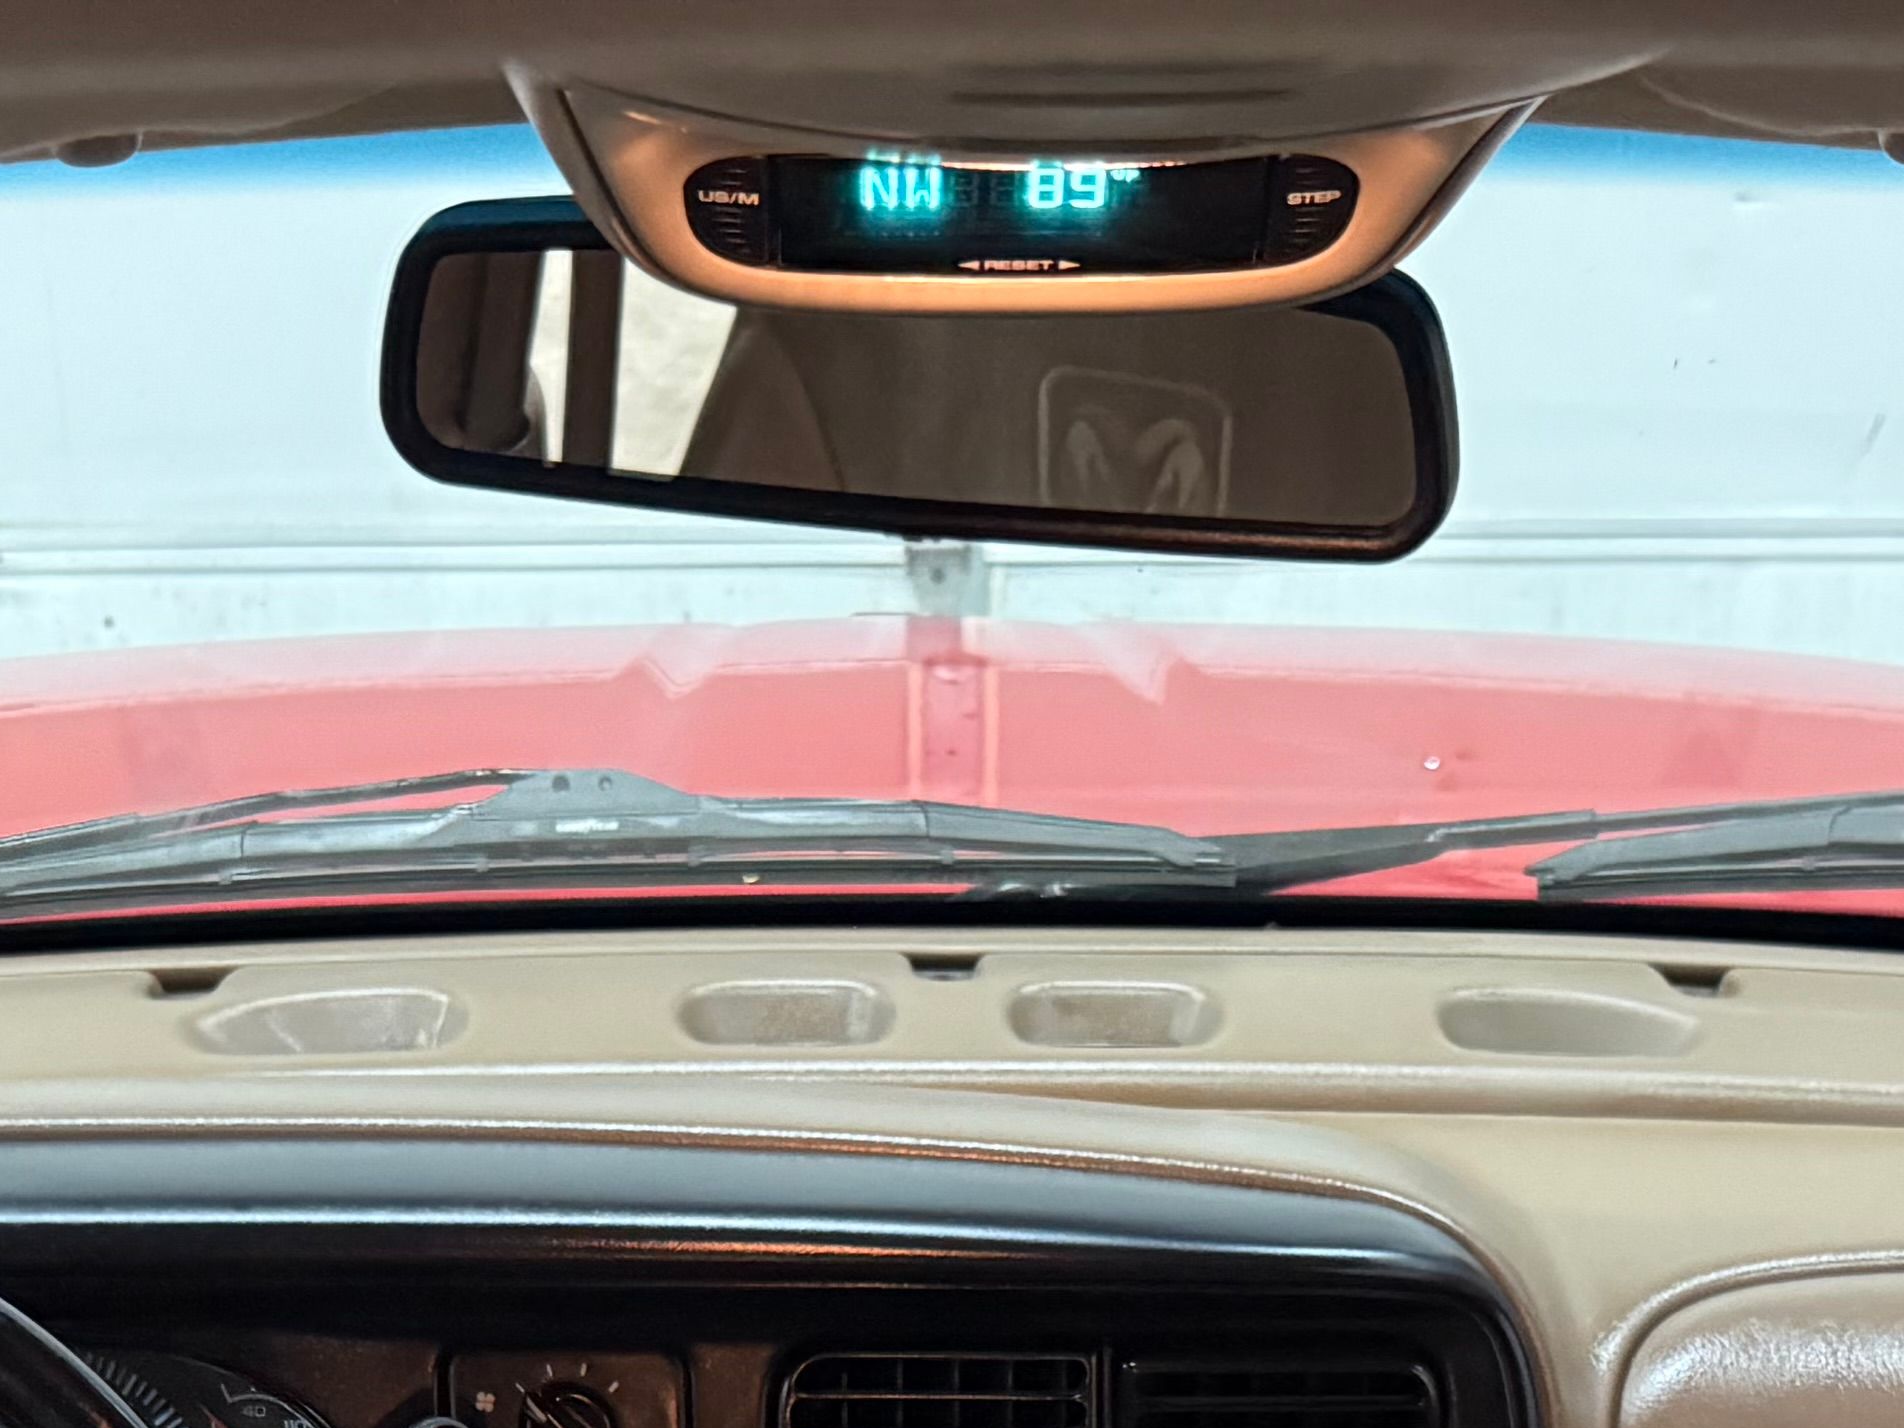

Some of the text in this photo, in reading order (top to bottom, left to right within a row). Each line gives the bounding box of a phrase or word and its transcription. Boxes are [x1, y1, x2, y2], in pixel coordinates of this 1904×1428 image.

[861, 166, 942, 211] NW
[1026, 164, 1108, 209] 89
[697, 189, 760, 206] US/M
[1286, 189, 1343, 206] STEP
[984, 258, 1055, 271] RESET
